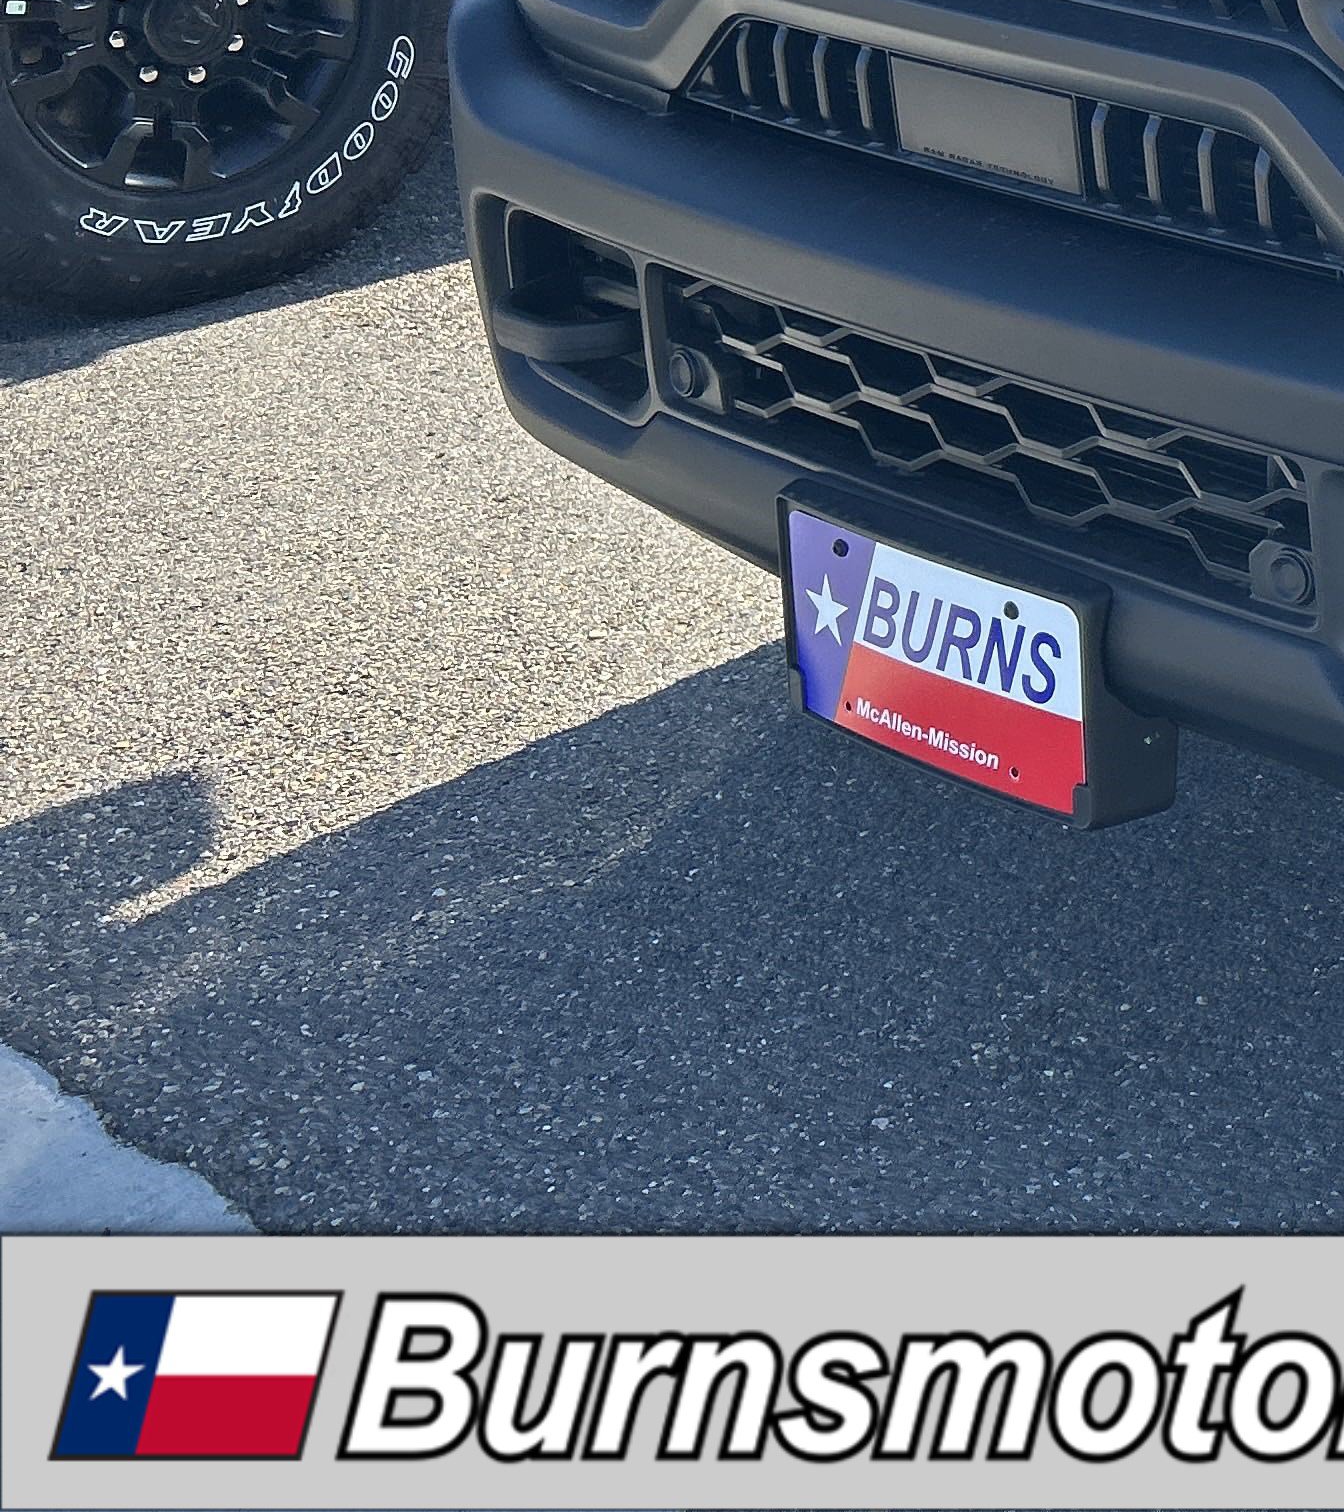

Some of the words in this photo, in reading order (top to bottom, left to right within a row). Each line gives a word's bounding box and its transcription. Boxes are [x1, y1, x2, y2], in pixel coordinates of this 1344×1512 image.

[79, 35, 415, 244] GOODYEAR
[862, 576, 1062, 705] BURNS
[855, 697, 999, 770] McAllen-Mission
